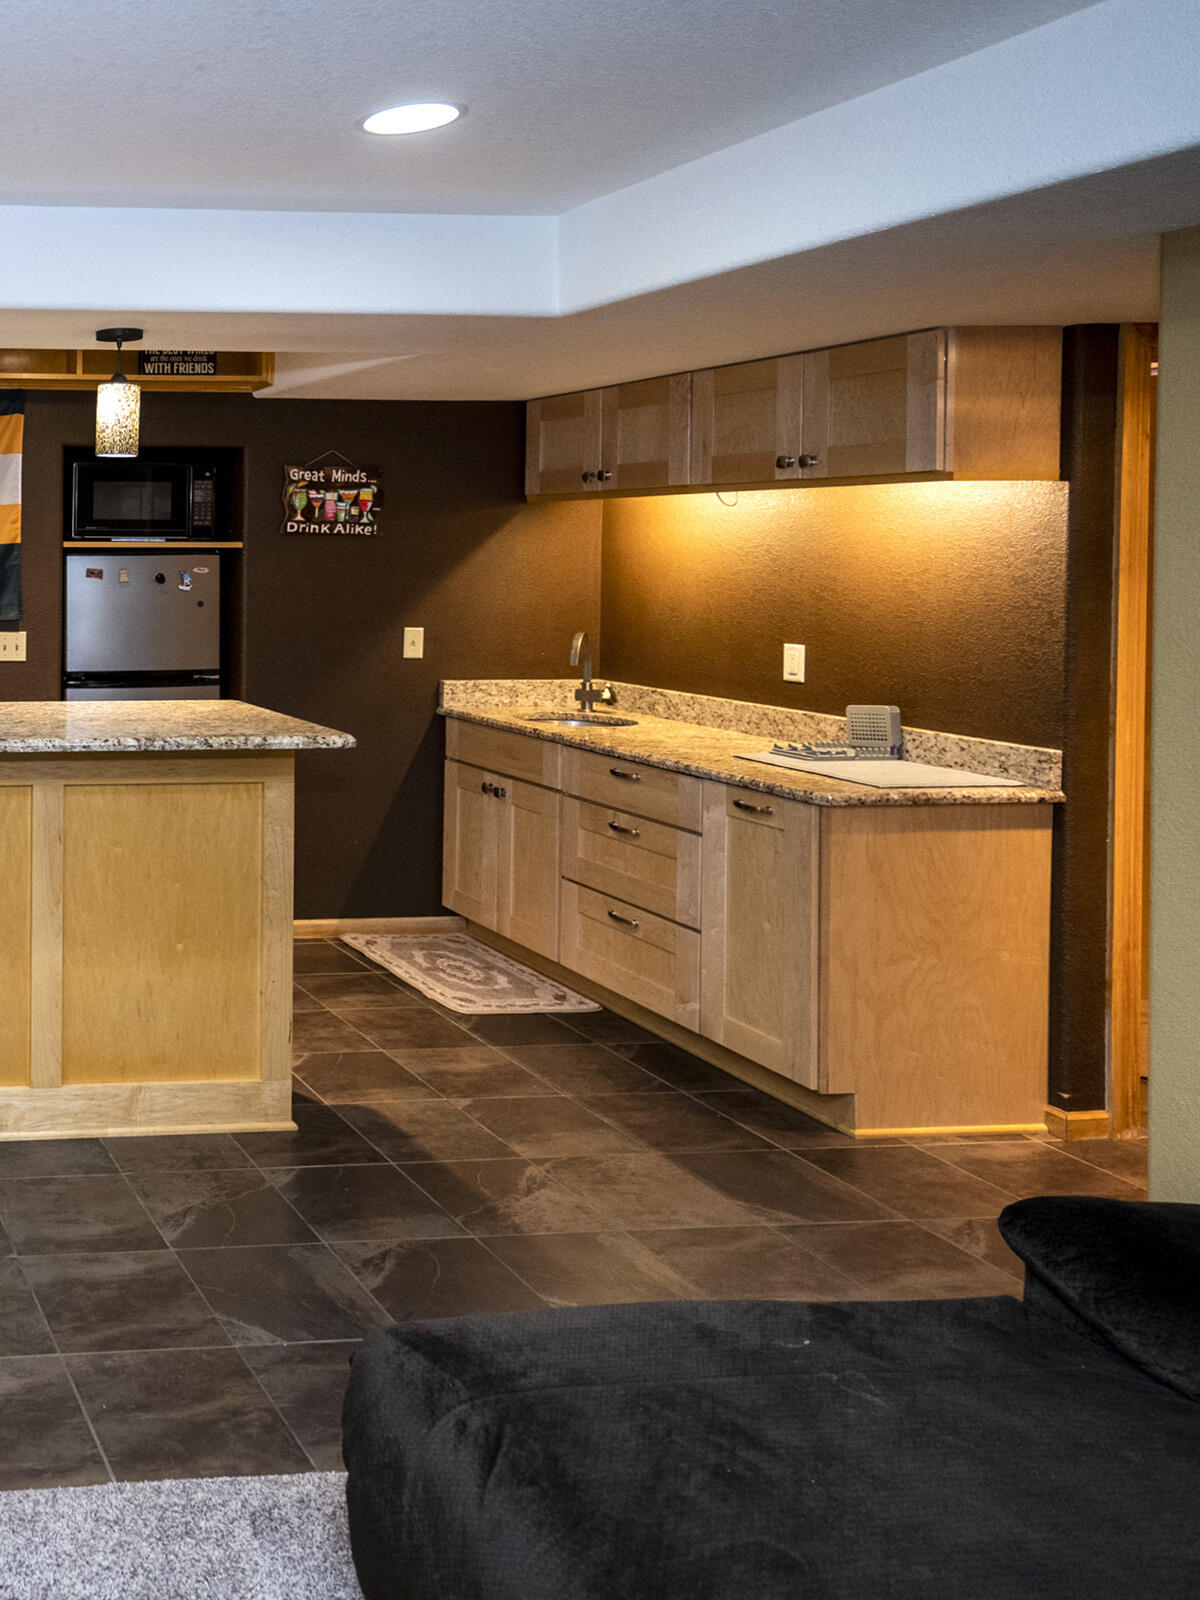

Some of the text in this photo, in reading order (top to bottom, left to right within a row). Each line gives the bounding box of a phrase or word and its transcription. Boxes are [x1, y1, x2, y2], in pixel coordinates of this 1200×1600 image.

[144, 362, 215, 374] WITH FRIENDS
[289, 469, 325, 482] Great
[286, 522, 377, 535] Drink Alike!
